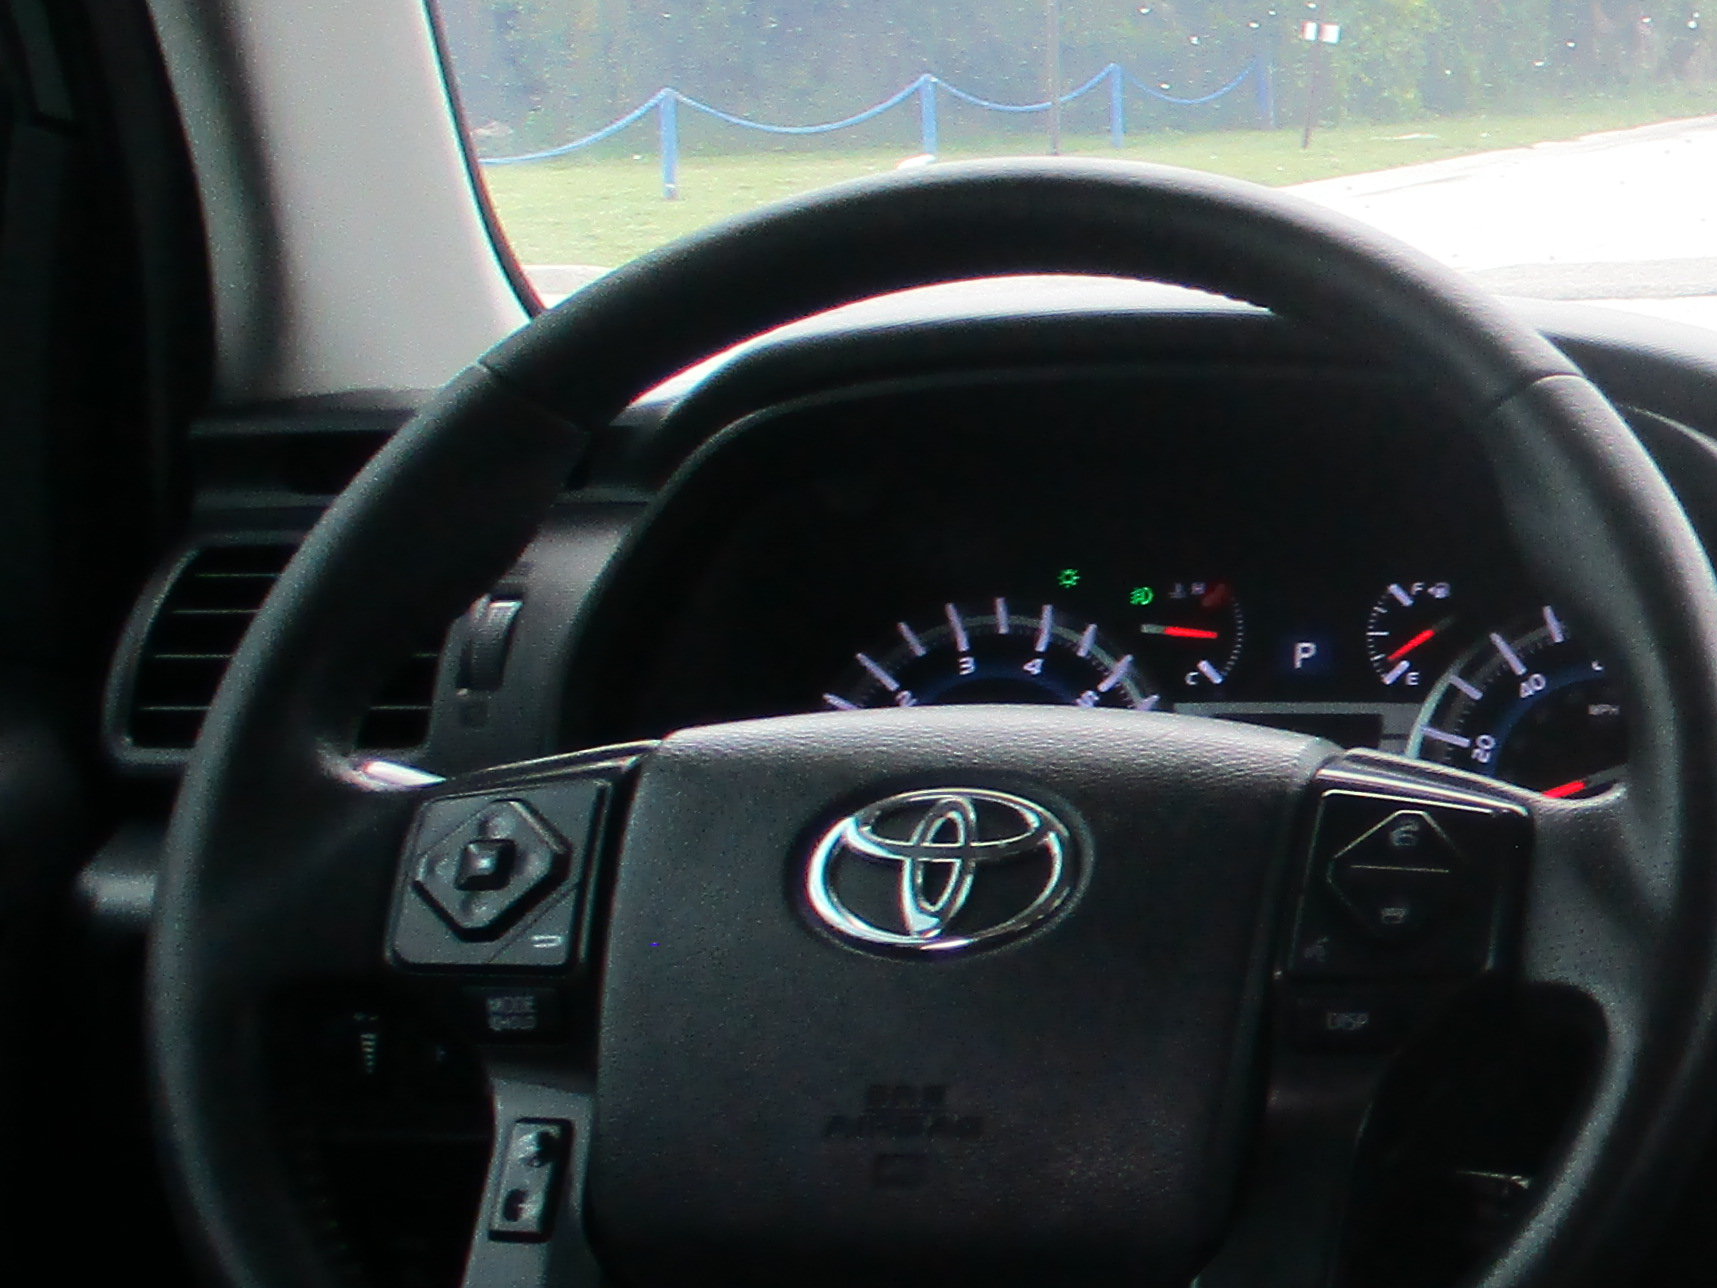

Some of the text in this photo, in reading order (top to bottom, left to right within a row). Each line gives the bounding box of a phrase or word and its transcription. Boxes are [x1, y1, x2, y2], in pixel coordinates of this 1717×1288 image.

[1412, 583, 1424, 595] F
[1295, 643, 1316, 669] P
[960, 658, 974, 673] 3
[1023, 658, 1043, 674] 4
[1185, 672, 1198, 685] C
[1406, 672, 1419, 685] E
[1519, 673, 1546, 698] 40
[1472, 735, 1495, 763] 20
